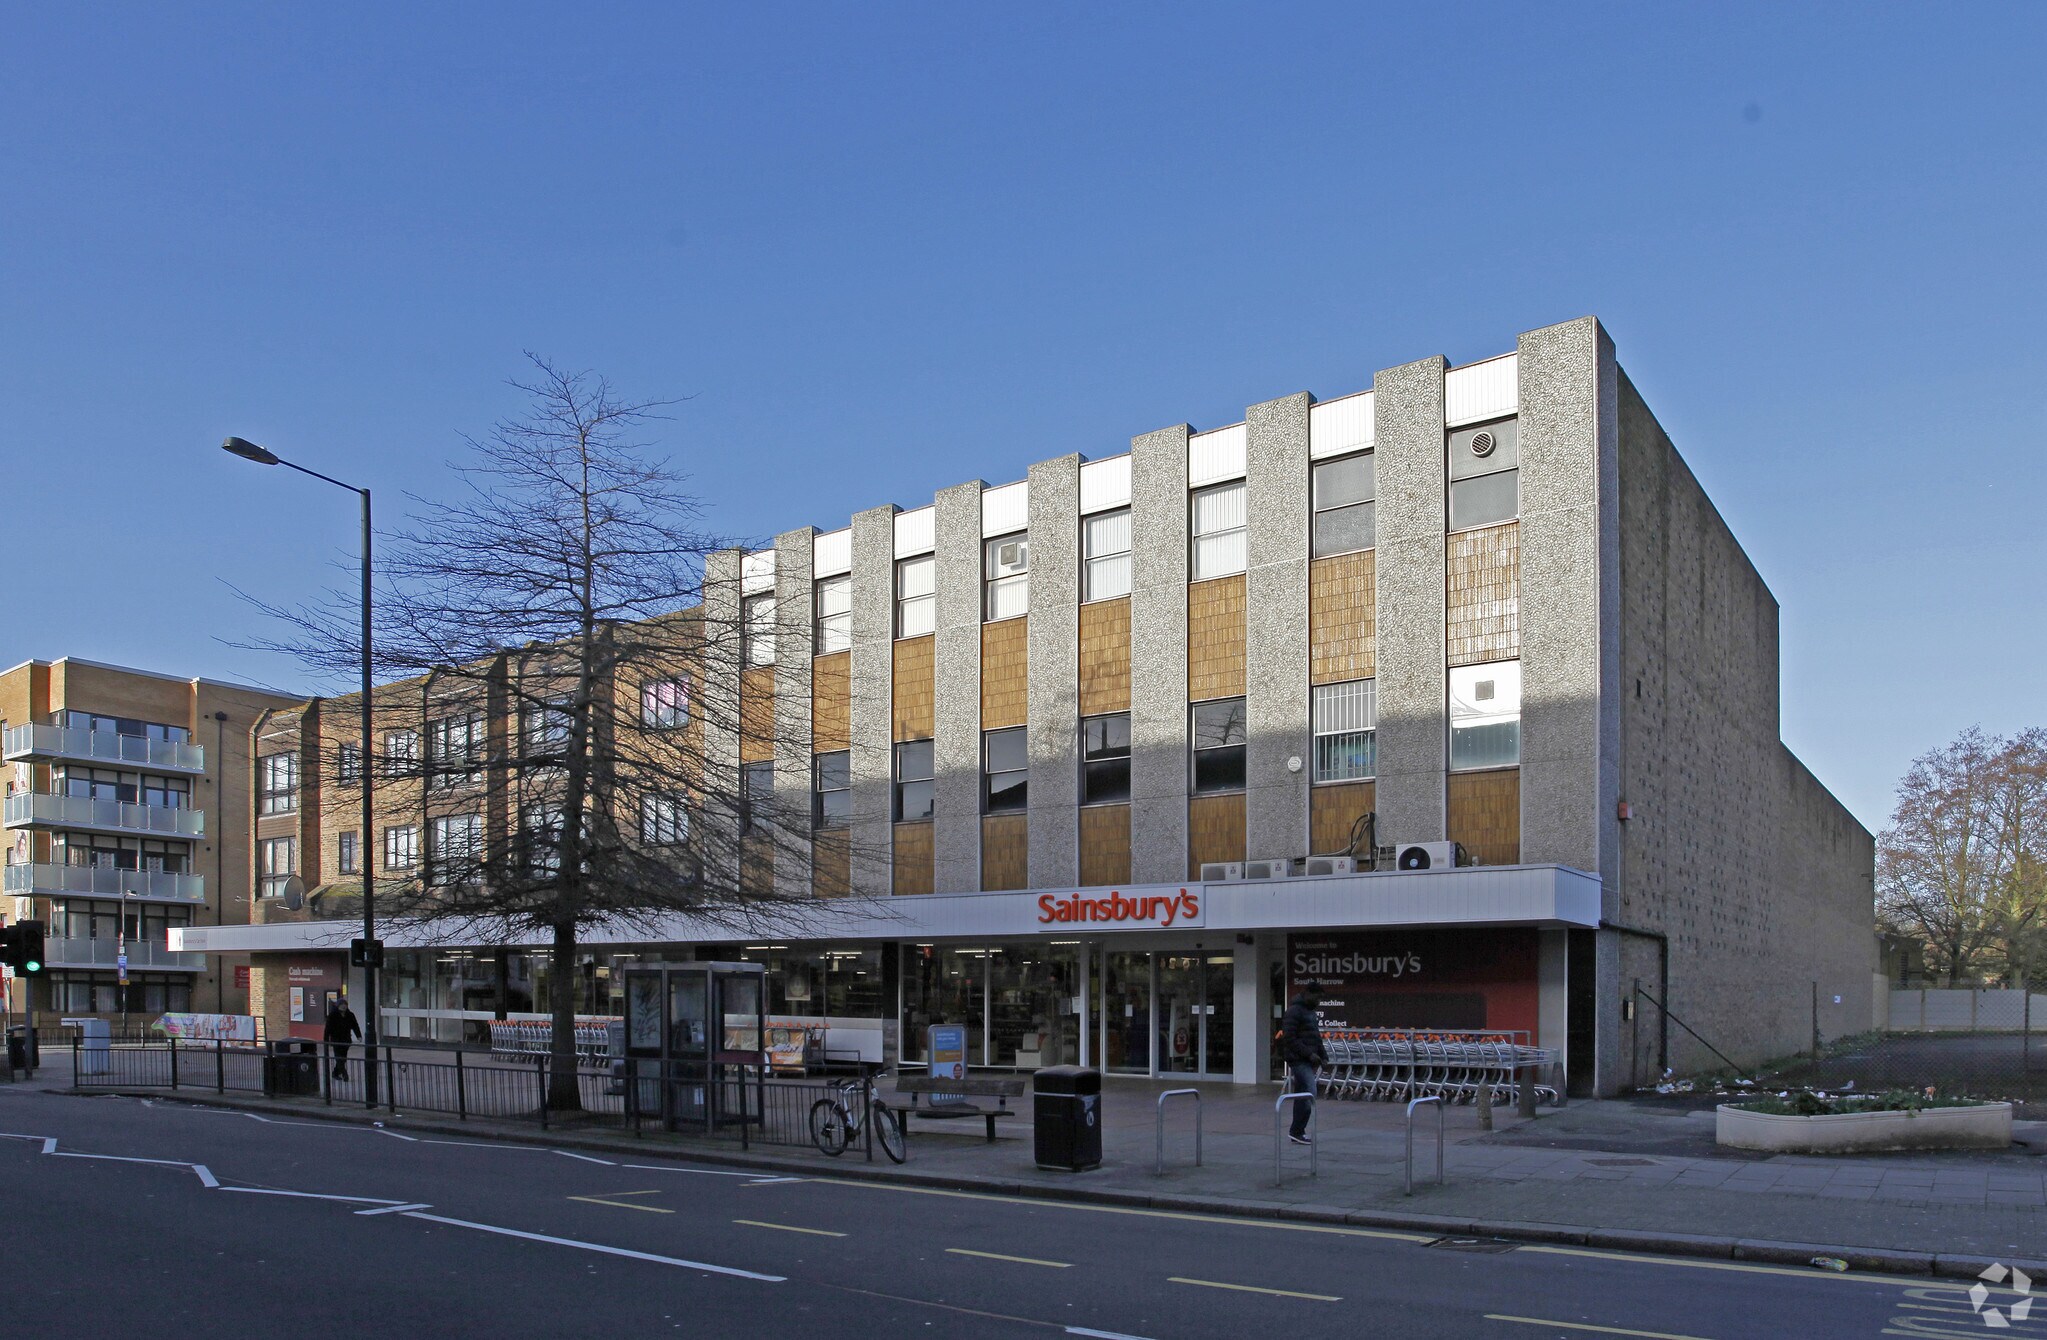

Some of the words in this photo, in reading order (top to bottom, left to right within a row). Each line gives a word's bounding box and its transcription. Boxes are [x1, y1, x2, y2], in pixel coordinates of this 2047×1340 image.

[1038, 888, 1199, 927] Sainsbury's
[1294, 952, 1421, 978] Sainsbury's
[1316, 977, 1345, 985] Harrow
